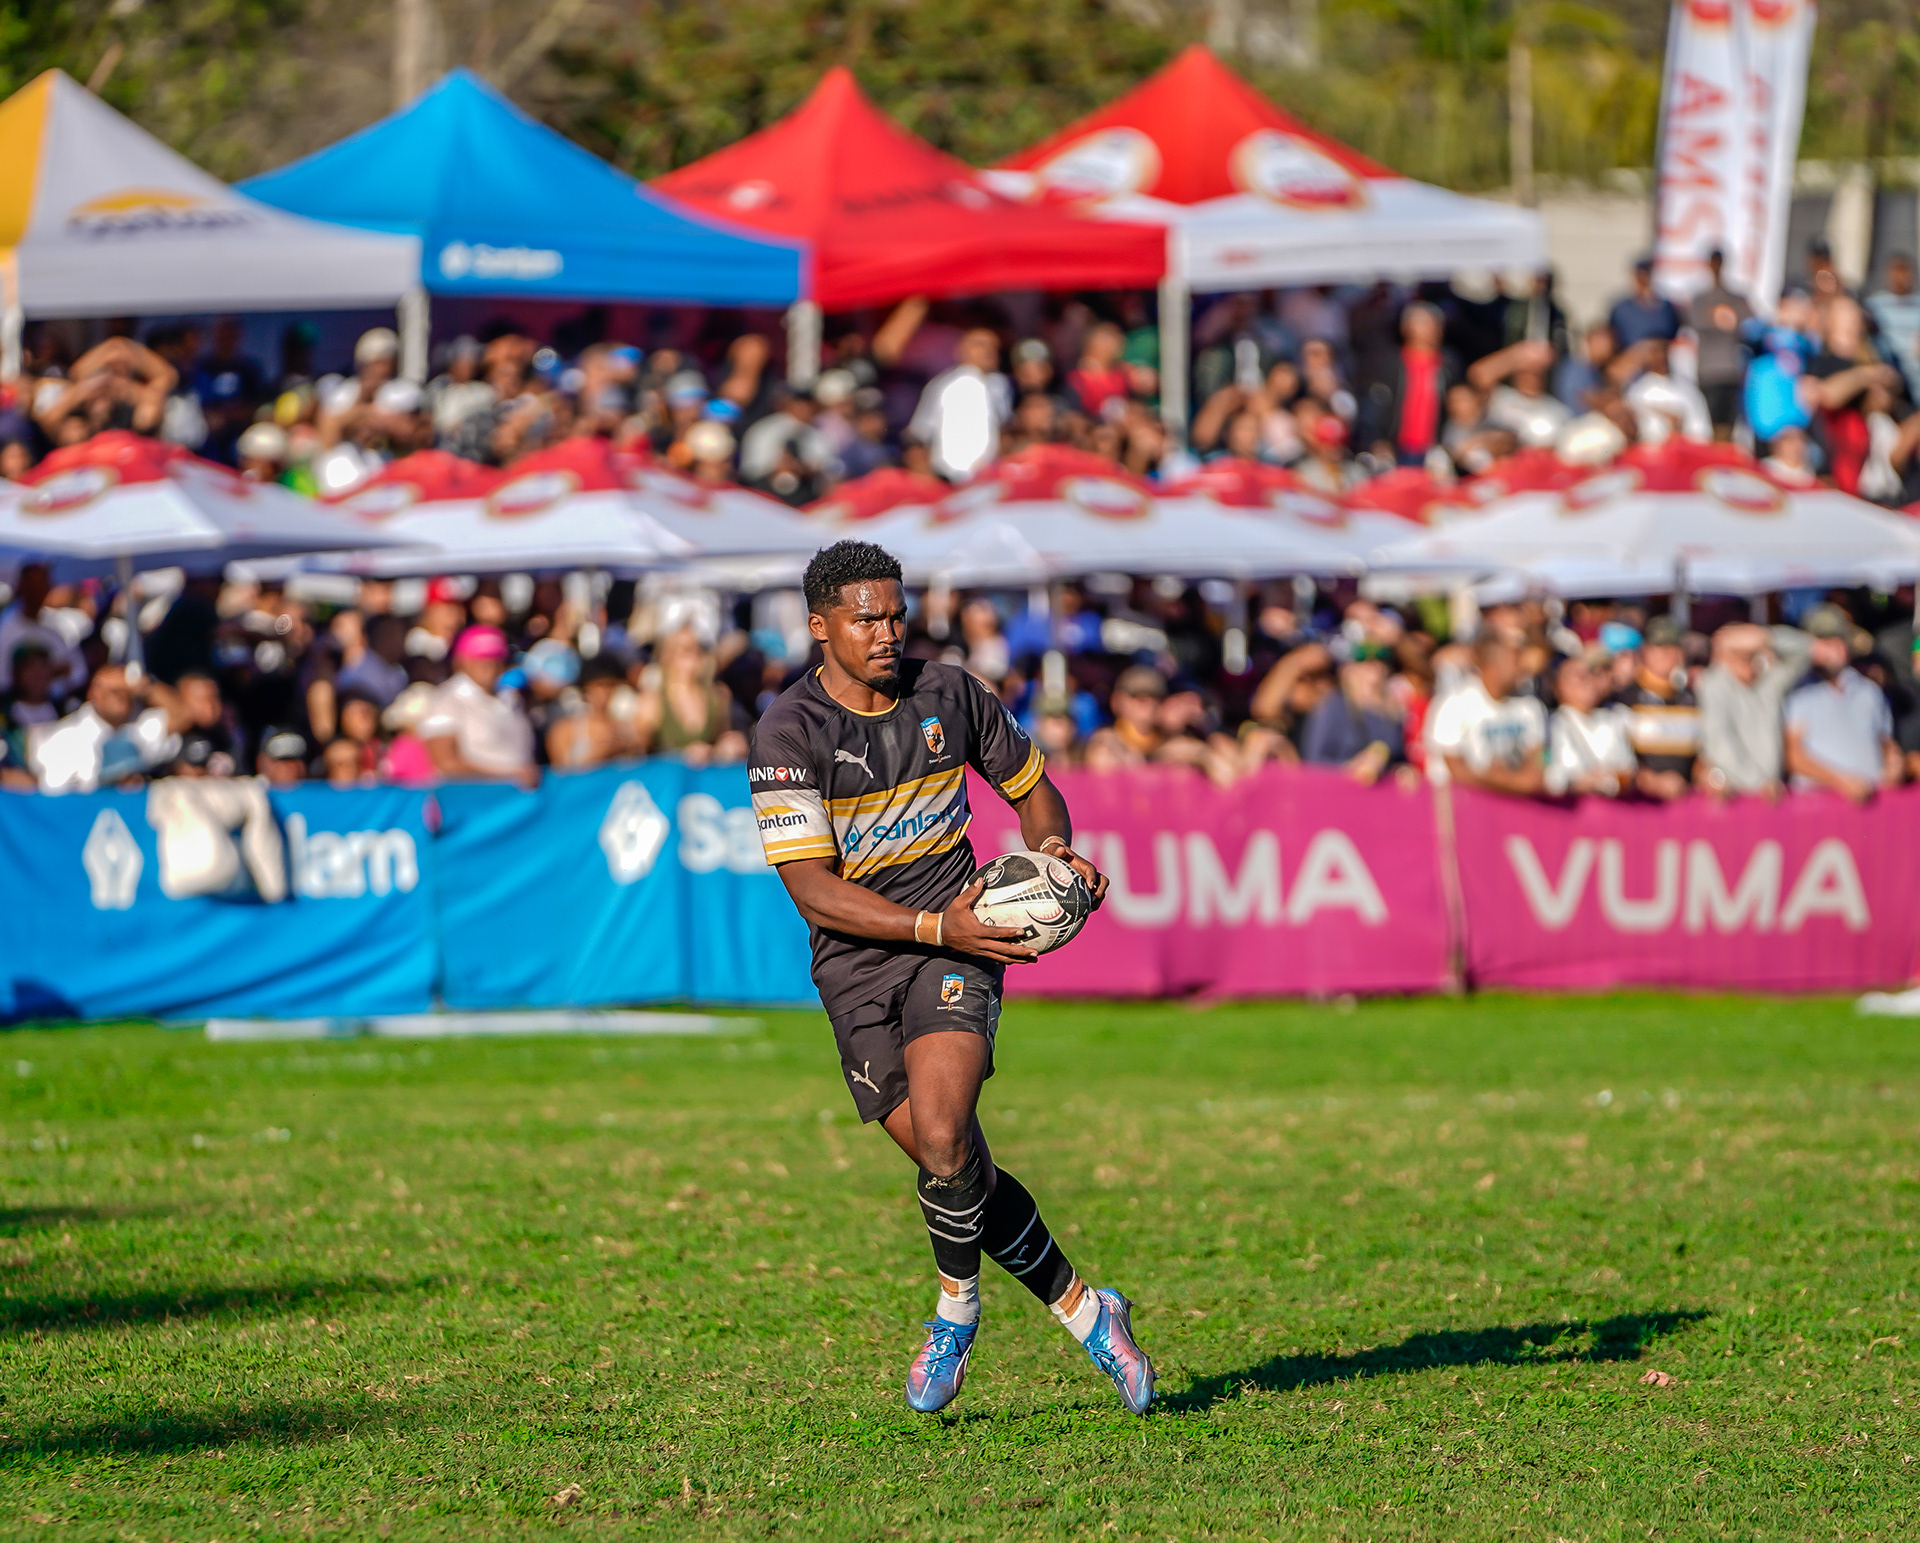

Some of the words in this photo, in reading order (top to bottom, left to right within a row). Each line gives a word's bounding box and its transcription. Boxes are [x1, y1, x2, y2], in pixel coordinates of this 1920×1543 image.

[749, 766, 807, 783] AINBOW
[285, 811, 420, 899] lam
[1505, 834, 1871, 934] VUMA
